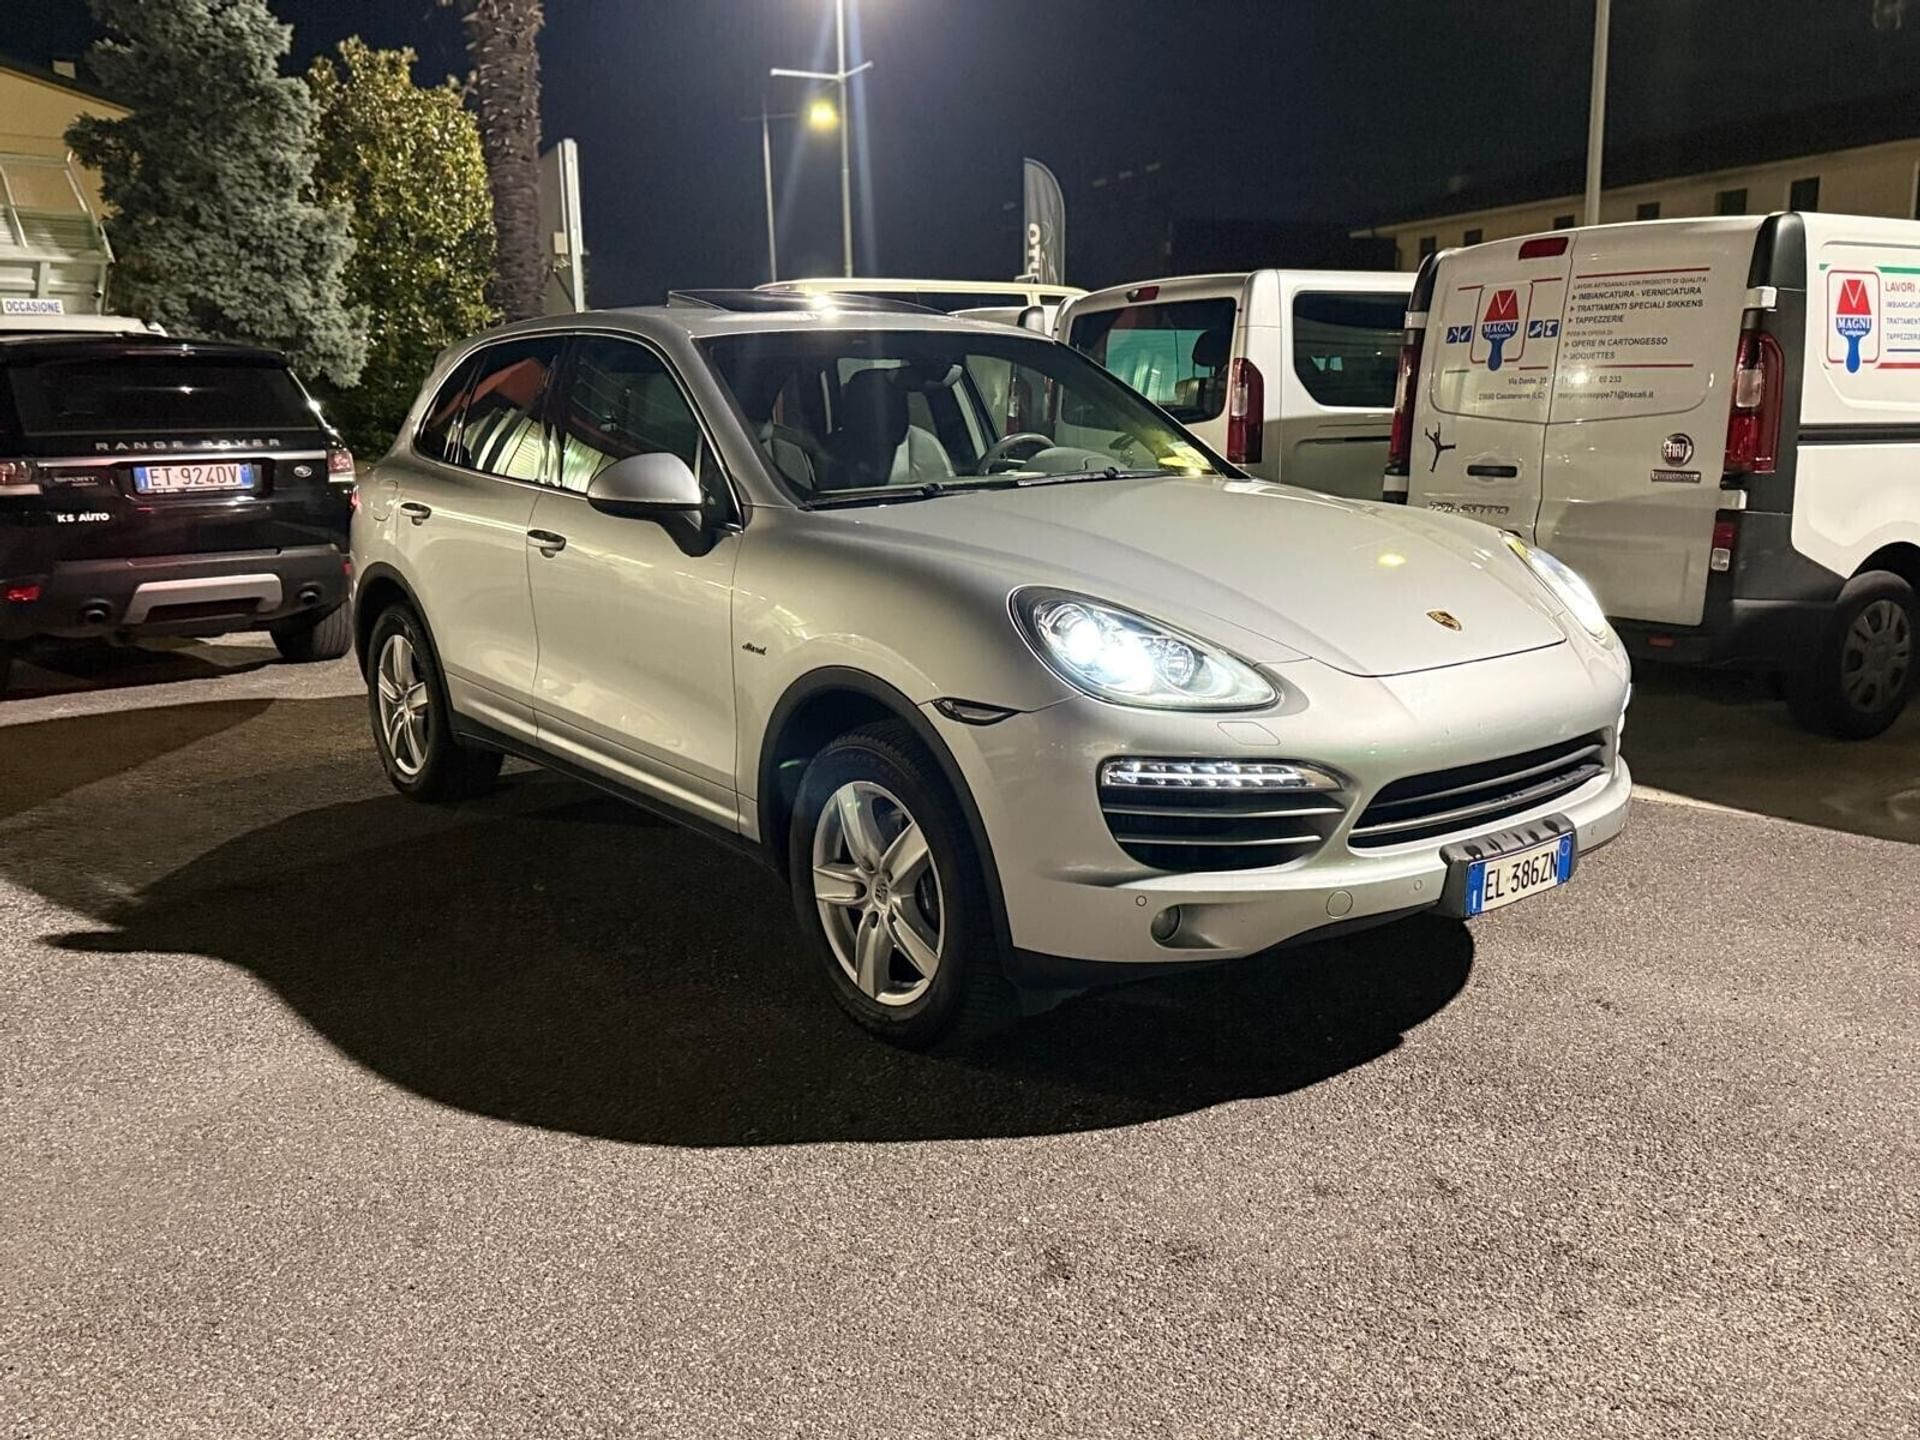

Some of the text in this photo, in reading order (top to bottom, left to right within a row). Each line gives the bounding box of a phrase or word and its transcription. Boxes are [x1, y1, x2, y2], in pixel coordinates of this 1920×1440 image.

[1641, 287, 1702, 296] VERNICIATURA
[1885, 281, 1915, 292] LAVORI
[6, 300, 61, 313] OCCASIONE
[1629, 301, 1665, 310] SPECIALI
[1483, 322, 1517, 333] MAGNI
[1837, 317, 1870, 329] MAGNI
[1607, 337, 1668, 346] CARTONGESSO
[96, 438, 281, 450] RANGE ROVER
[149, 468, 173, 486] ET
[180, 465, 238, 485] 924DV
[57, 511, 110, 523] KS AUTO
[1484, 868, 1505, 903] EL
[1510, 849, 1559, 894] 386ZN
